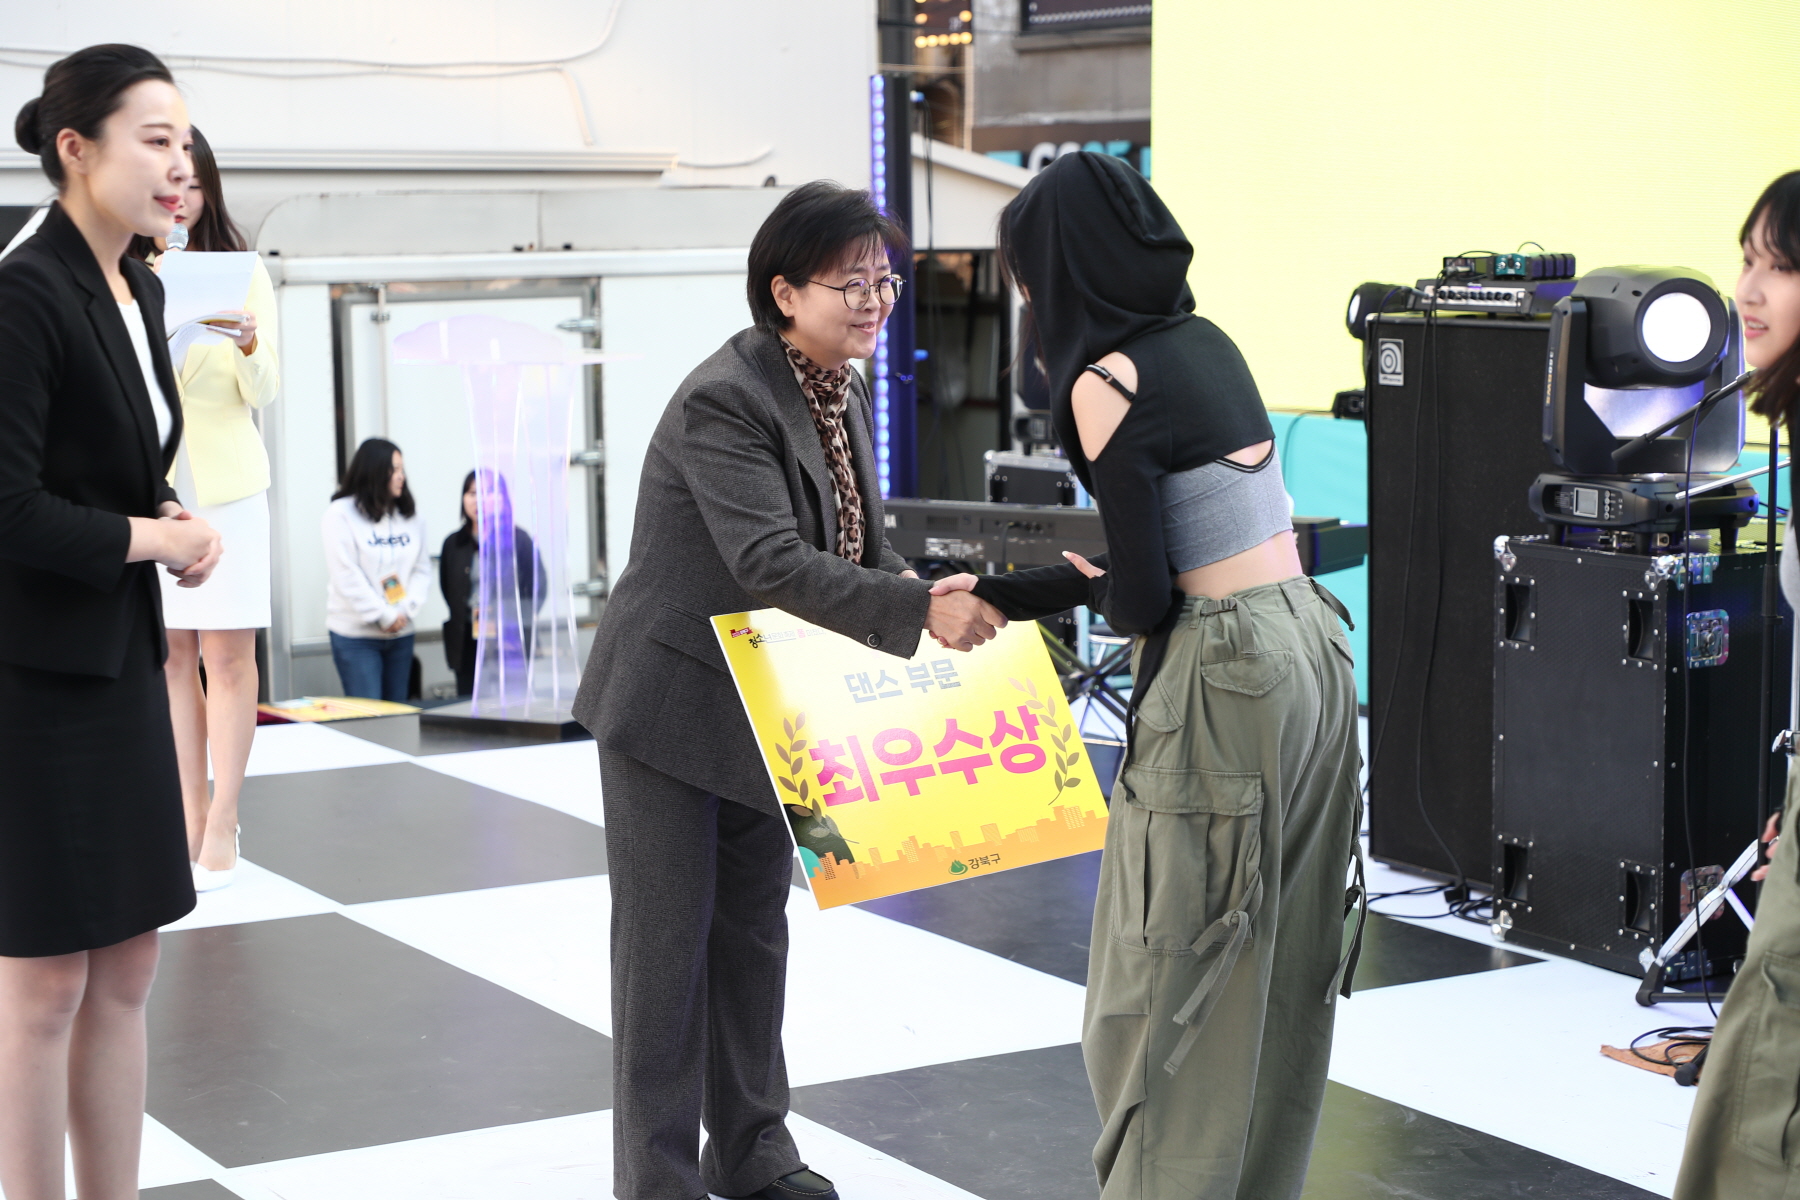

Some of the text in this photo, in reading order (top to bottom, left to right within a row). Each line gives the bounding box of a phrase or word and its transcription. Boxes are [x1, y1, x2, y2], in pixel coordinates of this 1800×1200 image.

[368, 530, 410, 546] Jeep
[844, 658, 962, 704] 댄스 부문
[808, 705, 1047, 808] 최우수상
[967, 853, 1001, 870] 강북구
